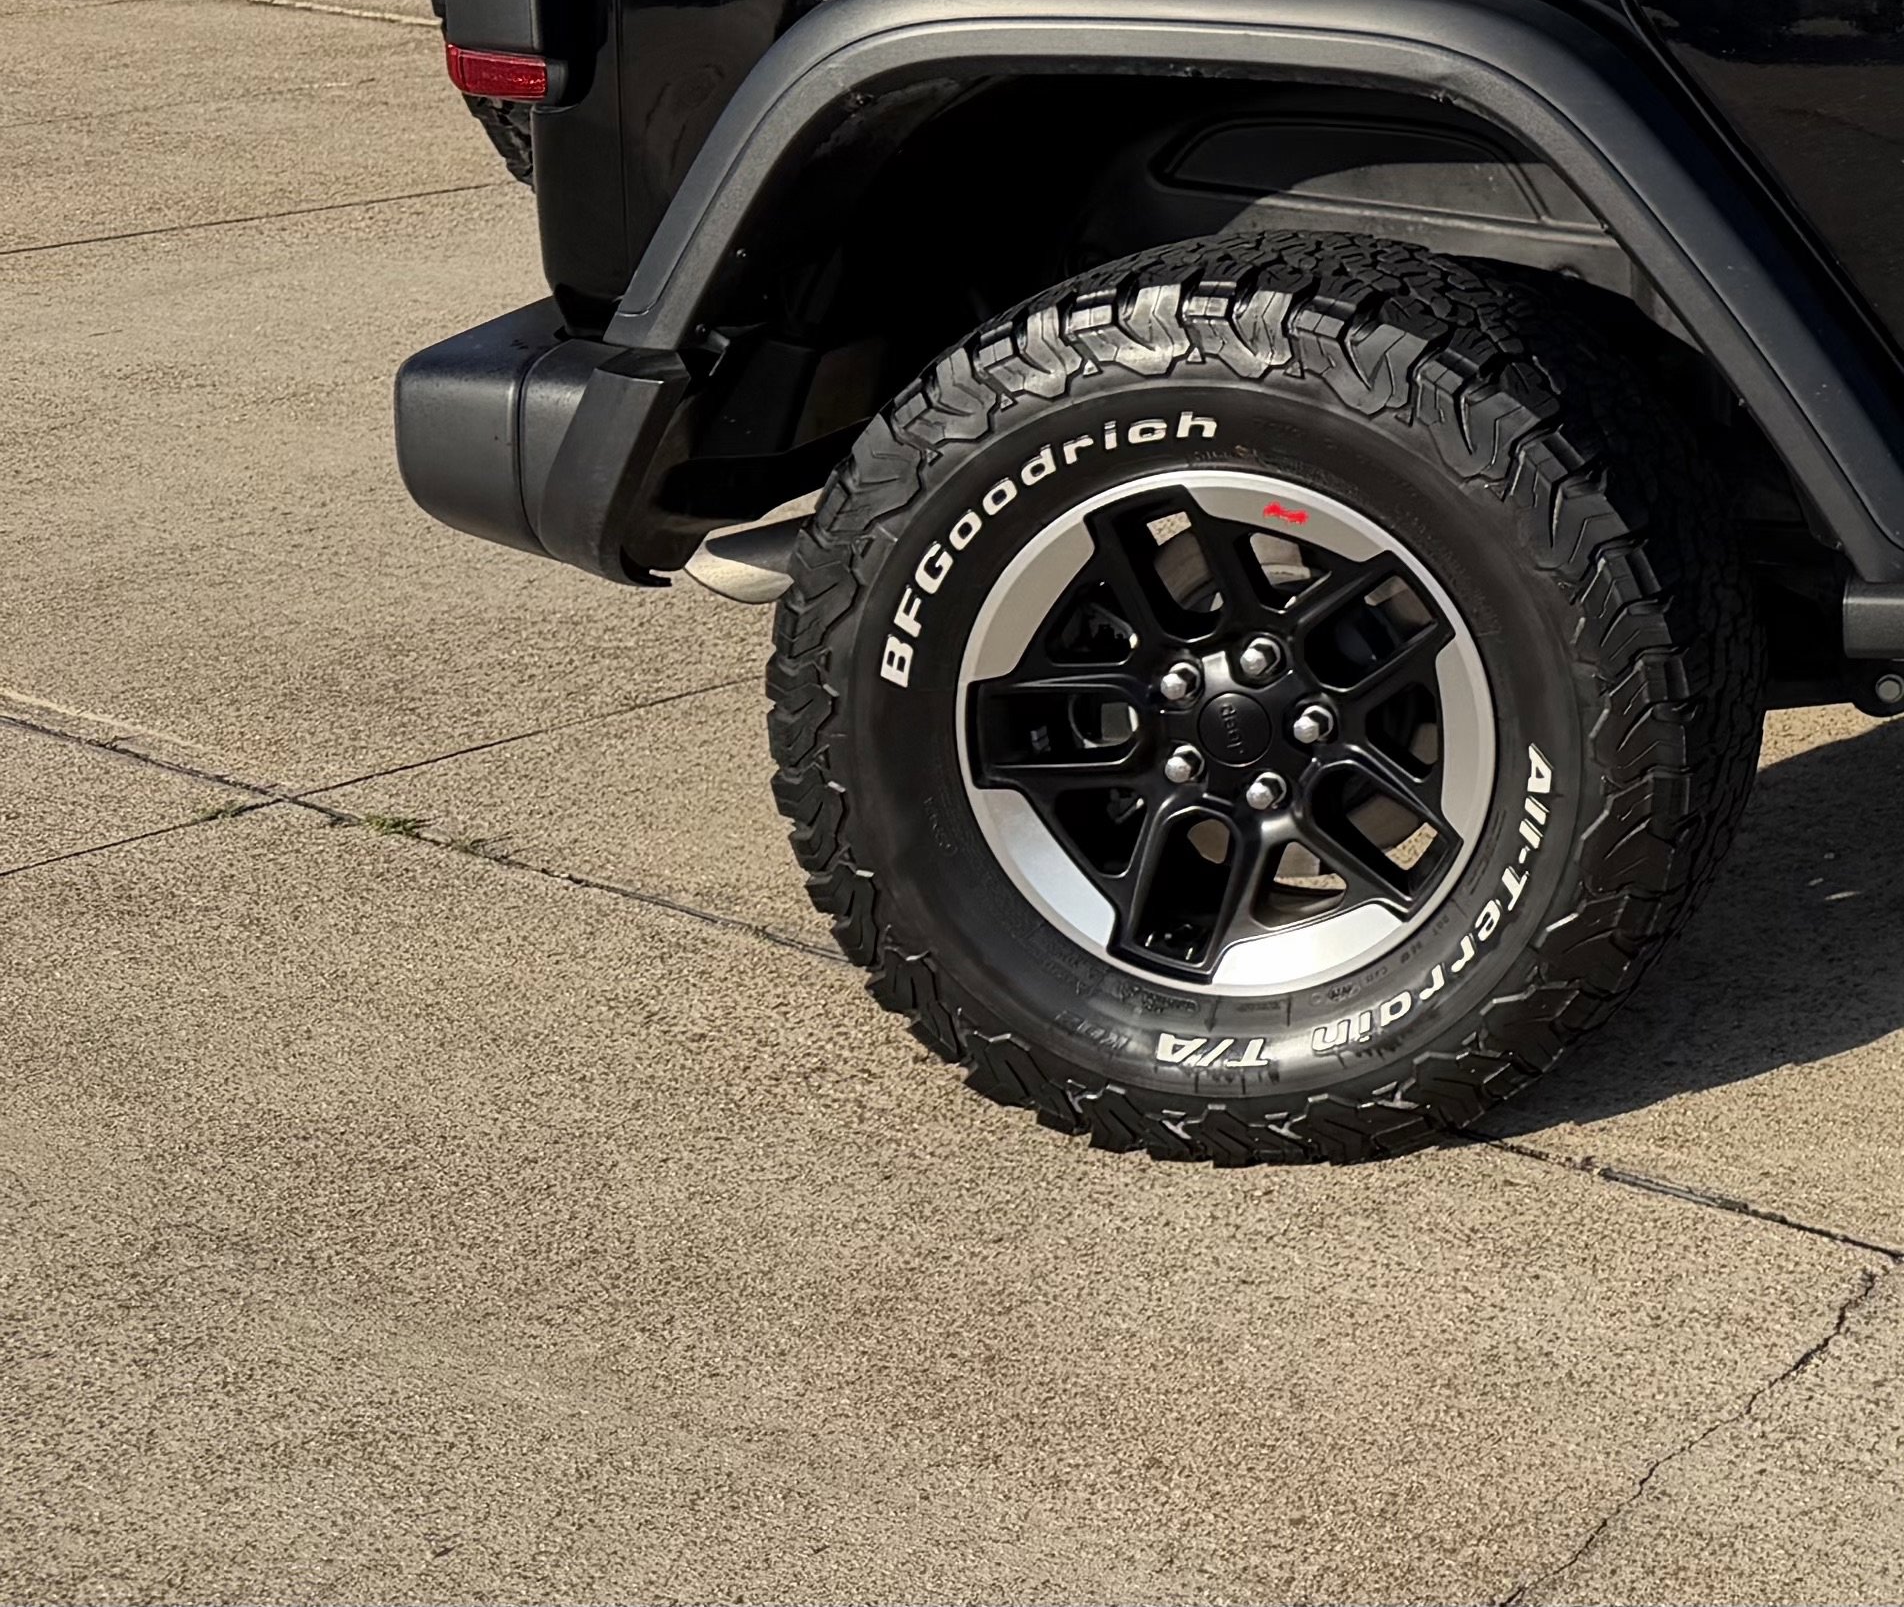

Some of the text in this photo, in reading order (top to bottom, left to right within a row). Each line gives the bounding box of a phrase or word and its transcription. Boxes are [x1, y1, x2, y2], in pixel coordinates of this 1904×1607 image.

[879, 411, 1218, 689] BFGoodrich
[1311, 744, 1552, 1056] All-Terrain
[1154, 1031, 1269, 1070] T/A
